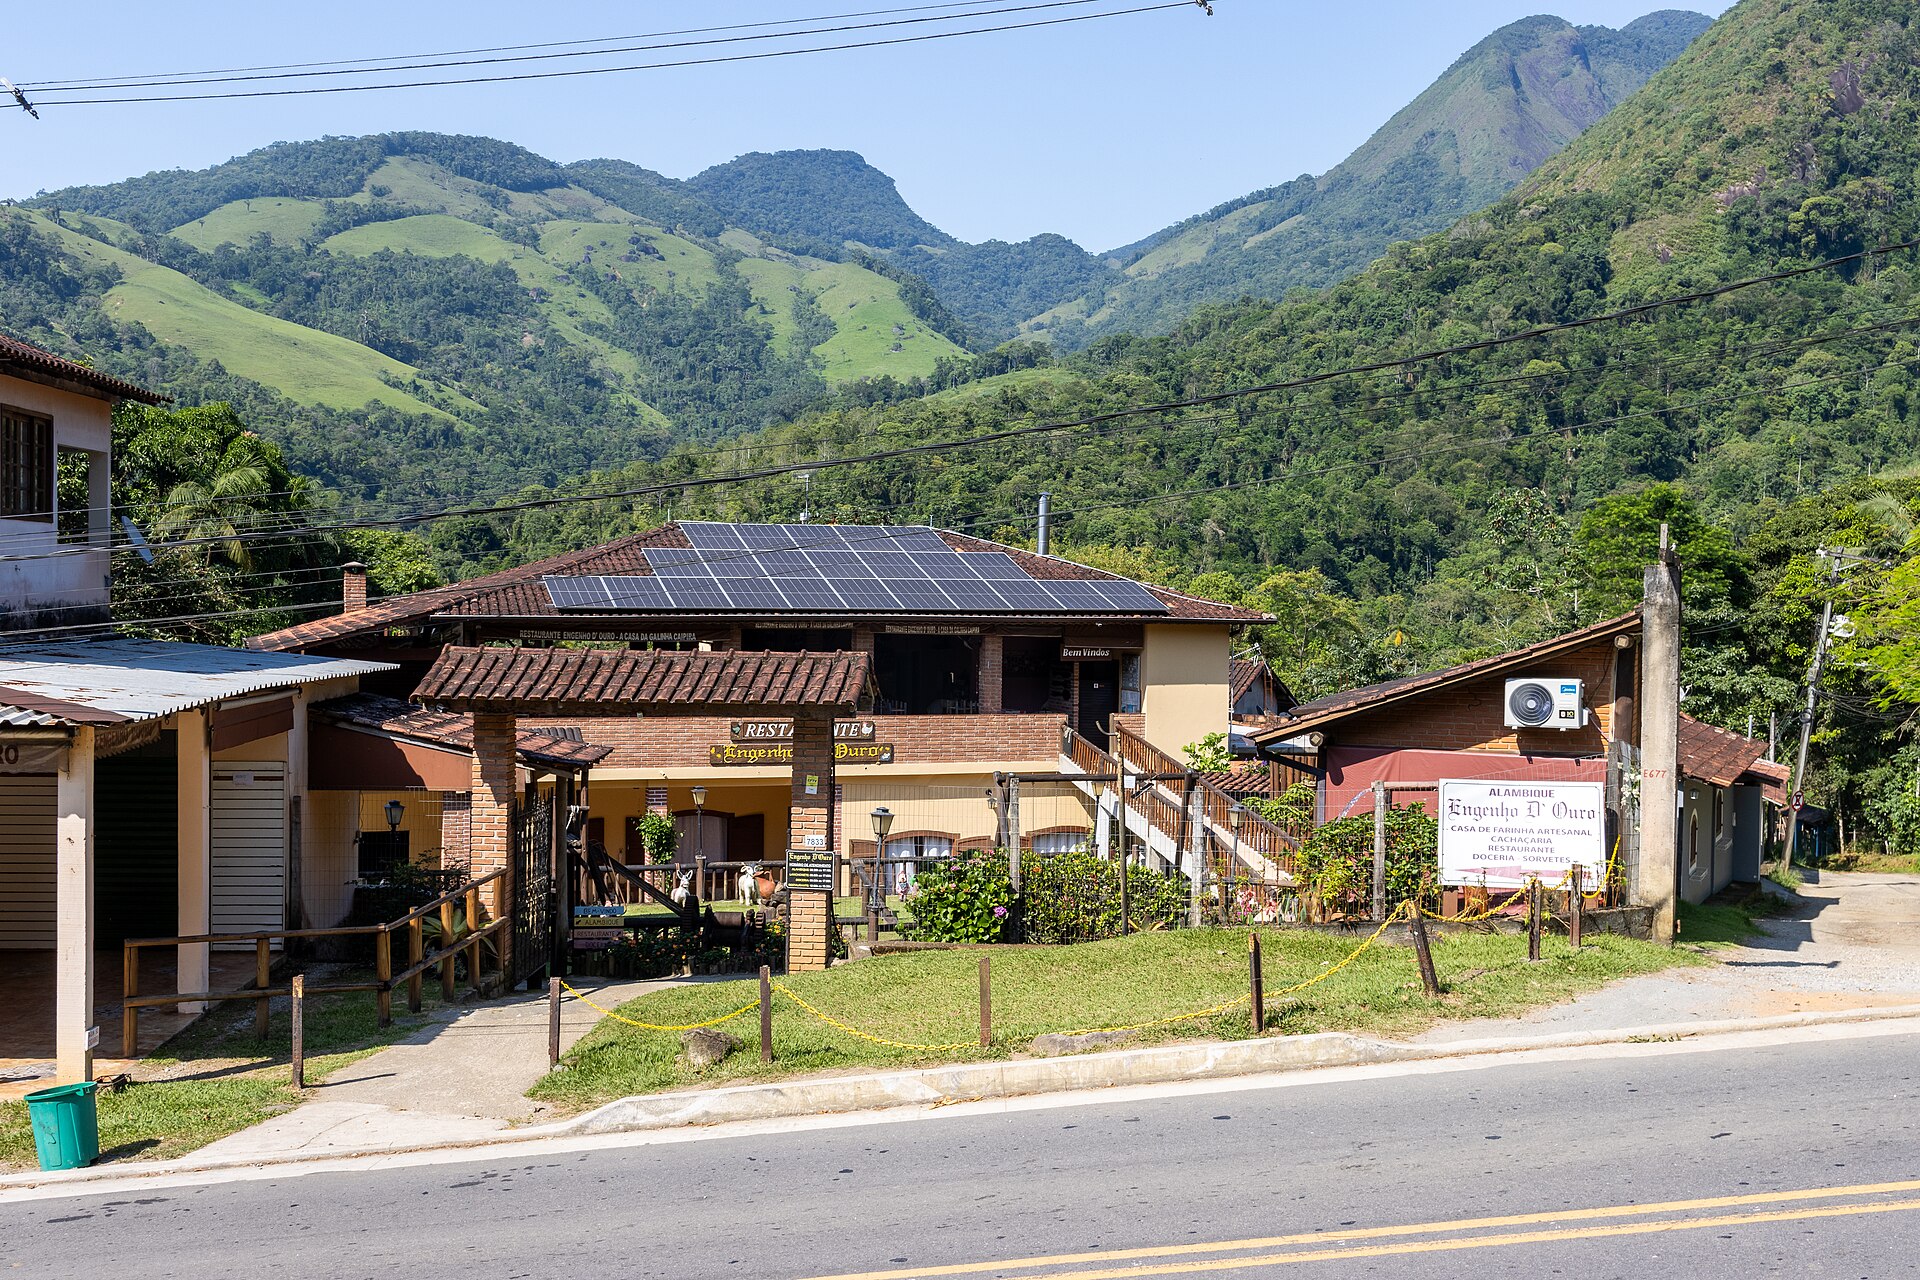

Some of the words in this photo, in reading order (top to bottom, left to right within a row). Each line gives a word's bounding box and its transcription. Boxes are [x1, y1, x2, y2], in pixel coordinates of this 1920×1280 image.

[520, 630, 561, 638] RESTAURANTE
[624, 632, 640, 640] CASA
[1083, 648, 1110, 656] Vindos
[1644, 769, 1667, 778] E677
[1489, 788, 1555, 798] ALAMBIQUE
[1447, 798, 1518, 822] Engenho
[1552, 801, 1596, 820] Ouro
[1490, 836, 1553, 844] CACHAÇARIA
[1488, 845, 1556, 854] RESTAURANTE
